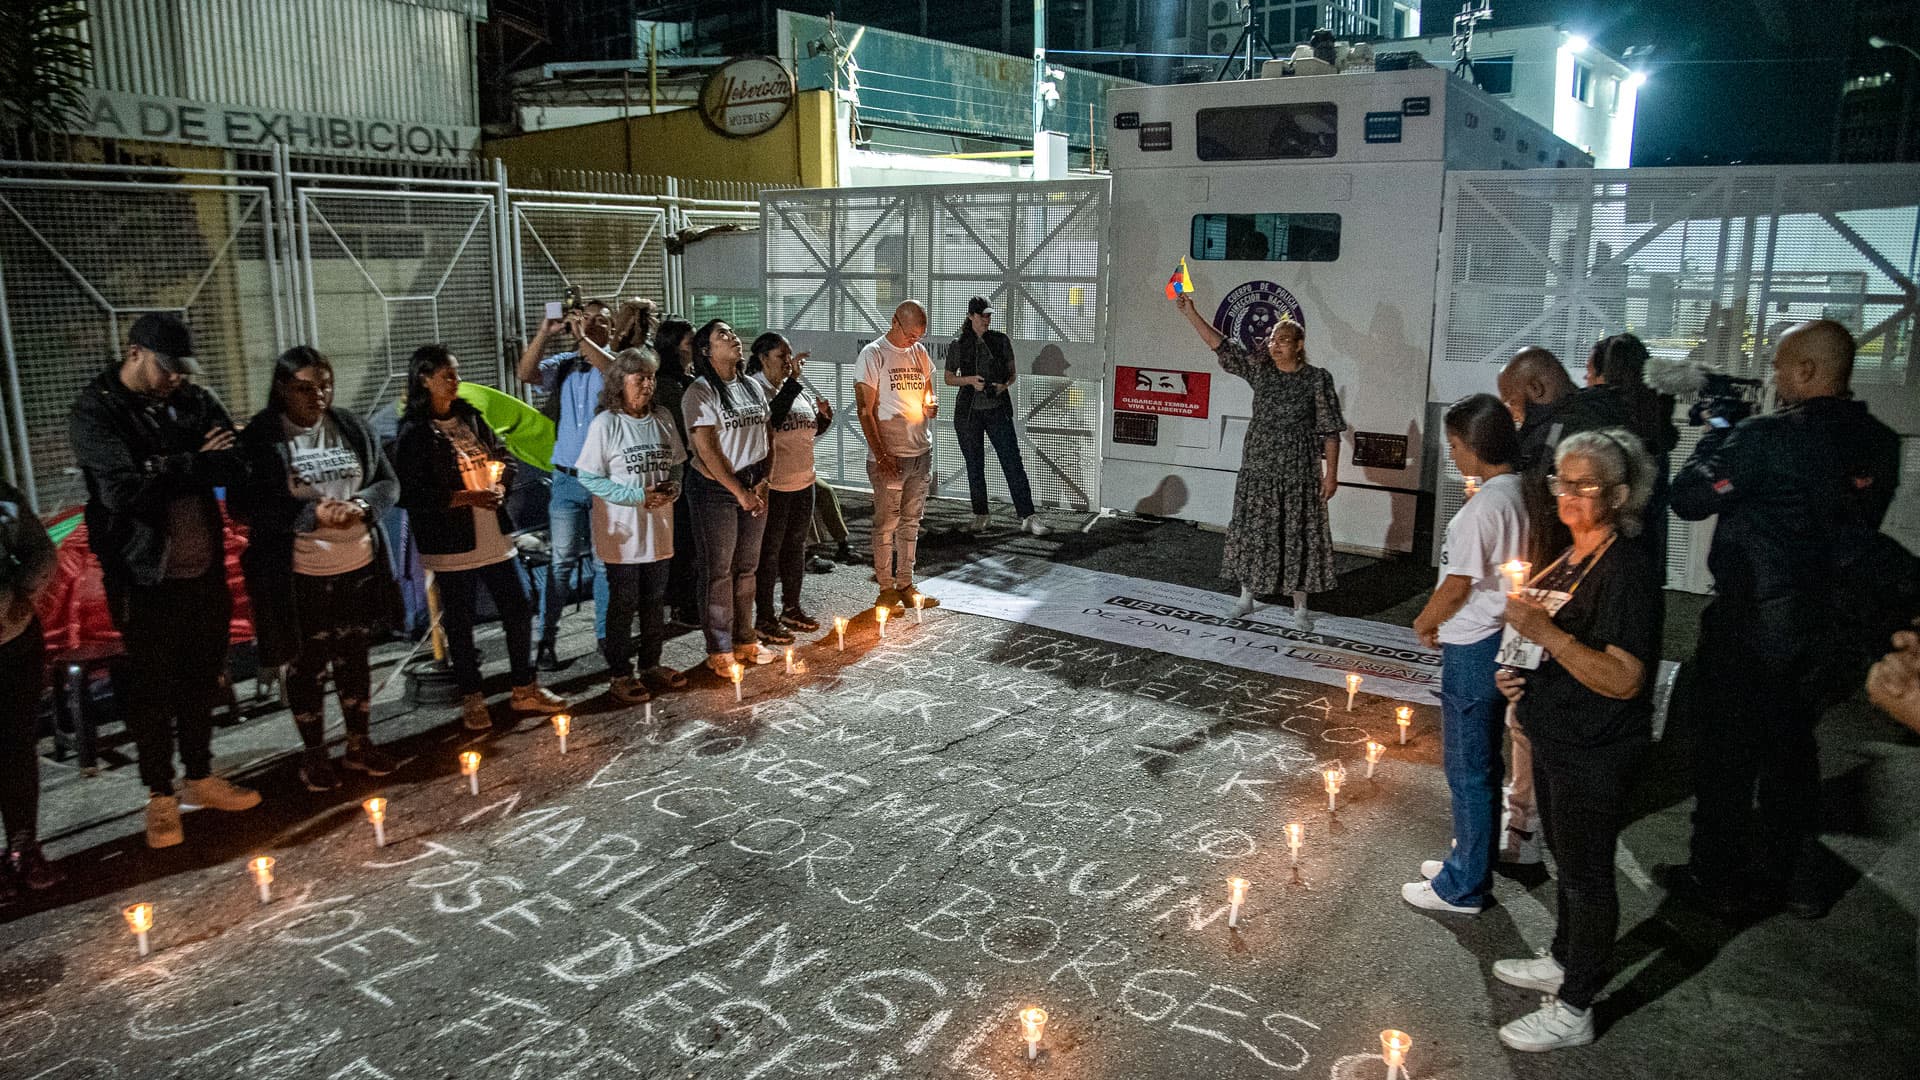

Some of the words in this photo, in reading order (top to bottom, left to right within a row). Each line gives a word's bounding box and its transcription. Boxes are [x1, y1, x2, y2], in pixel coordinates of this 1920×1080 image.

[141, 103, 209, 142] DE
[224, 110, 460, 159] EXHIBICION
[728, 112, 770, 126] MUEBLES
[1227, 284, 1253, 303] CUERPO
[1260, 282, 1269, 291] DE
[889, 374, 903, 382] LOS
[1121, 397, 1163, 406] OLIGARCAS
[1157, 406, 1193, 414] LIBERTAD
[624, 452, 644, 464] LOS
[1081, 607, 1110, 620] DE
[1117, 614, 1191, 637] ZONA
[1218, 634, 1238, 646] A
[1245, 640, 1280, 655] LA
[1110, 596, 1243, 629] LIBERTAD
[1247, 622, 1325, 644] PARA
[1337, 637, 1442, 667] TODOS
[1102, 672, 1370, 741] VELAZCO
[1162, 664, 1330, 719] PEREA
[635, 720, 872, 808] JORGE
[360, 840, 578, 943] JOSE
[586, 751, 858, 887] VICTOR
[904, 884, 1321, 1071] BORGES
